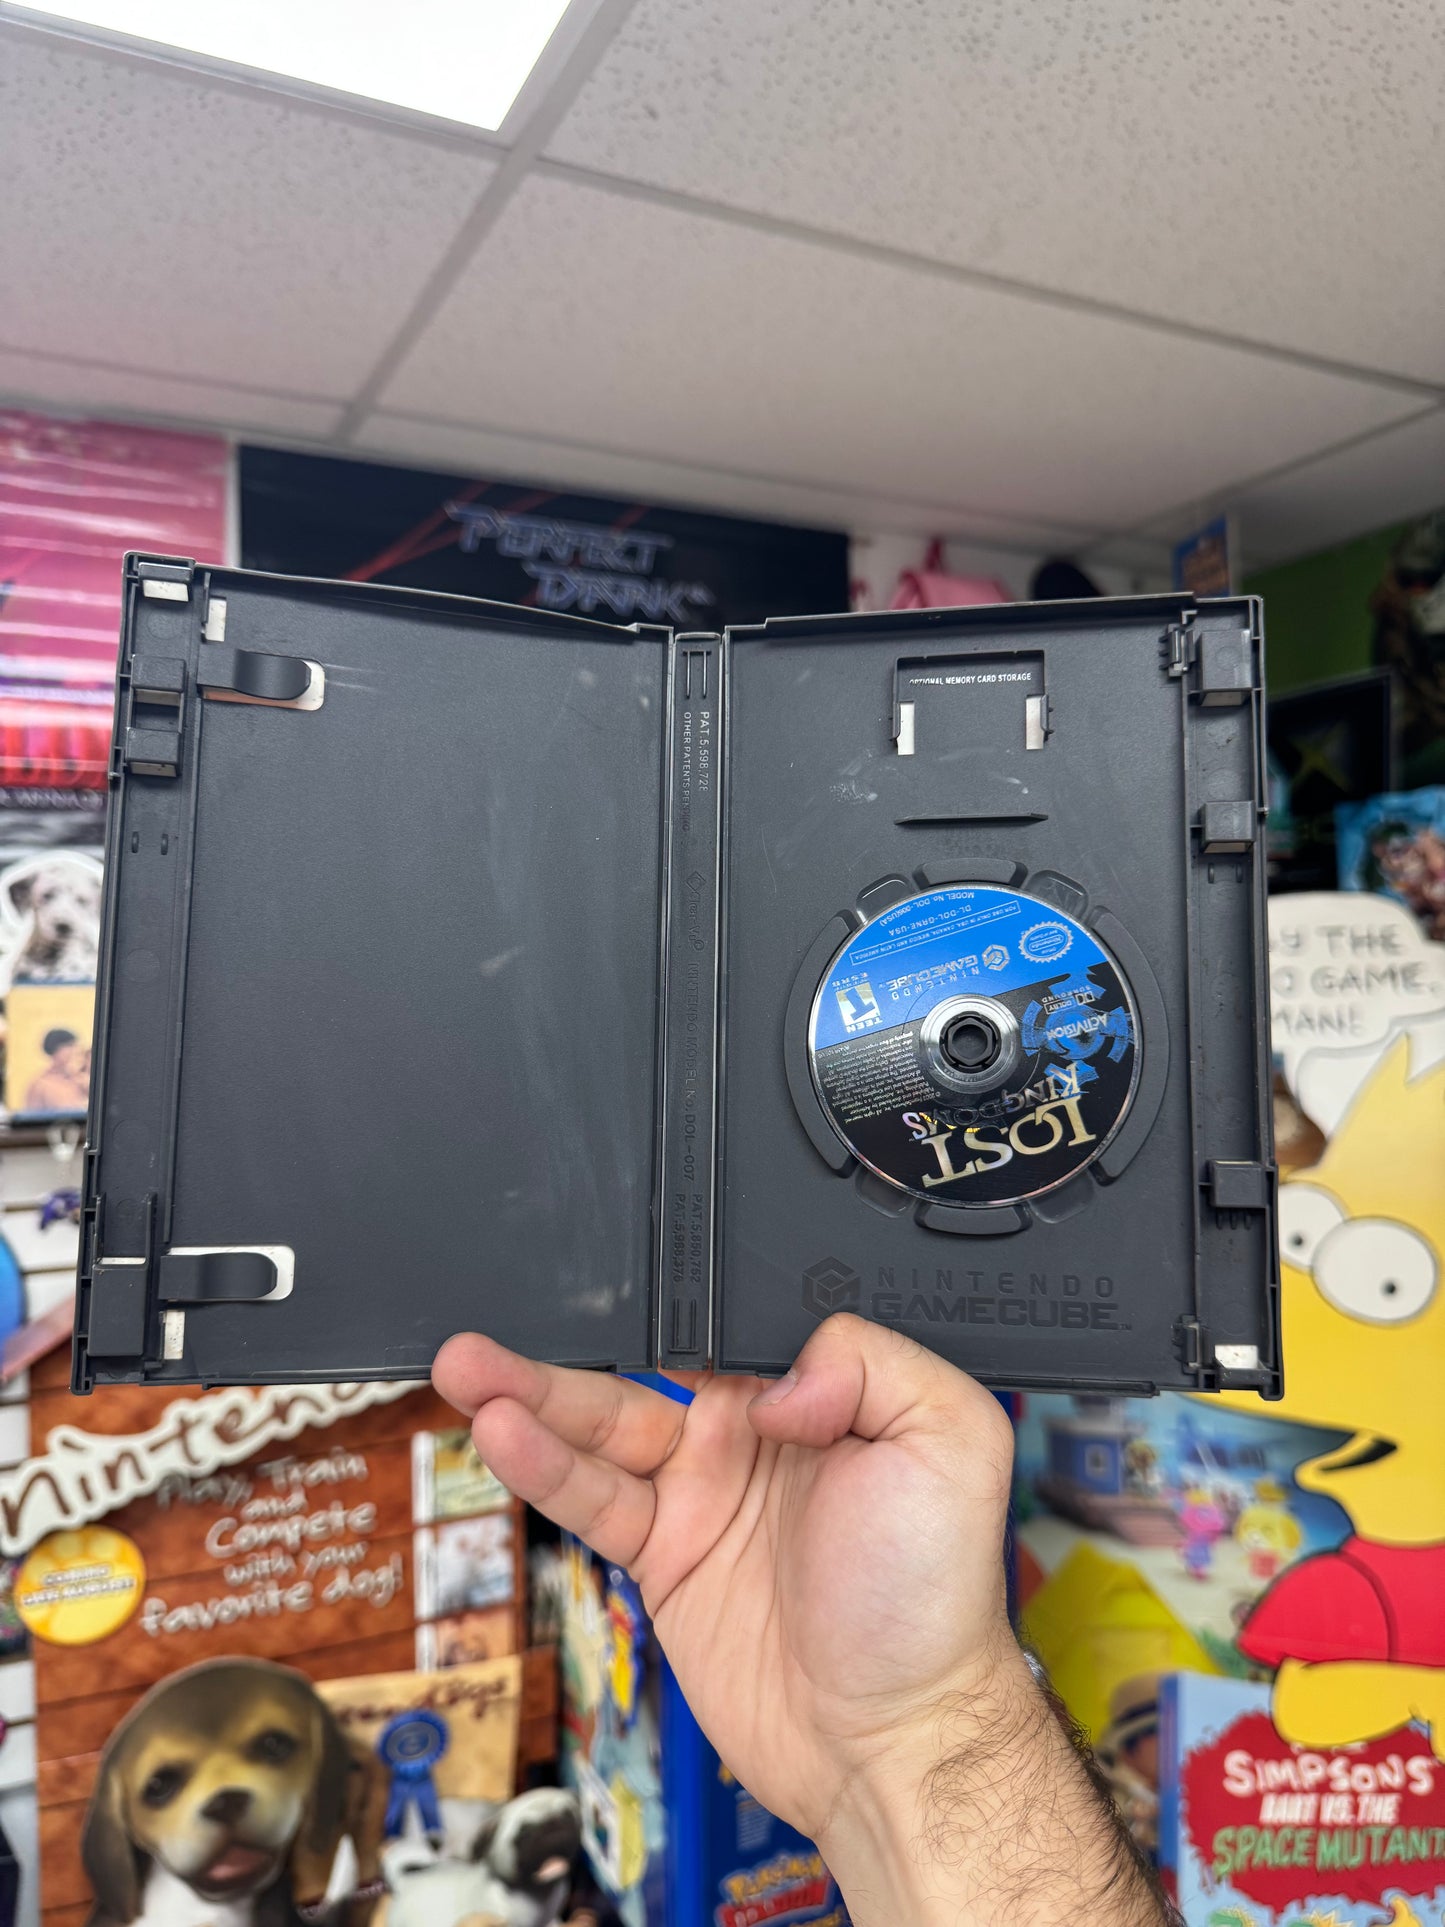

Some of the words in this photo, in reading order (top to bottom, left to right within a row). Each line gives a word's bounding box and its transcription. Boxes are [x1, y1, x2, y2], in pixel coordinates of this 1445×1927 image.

[444, 502, 676, 575] PERFECT
[945, 676, 974, 684] MEMORY
[977, 675, 996, 683] CARD
[998, 672, 1030, 681] STORAGE
[682, 711, 691, 743] OTHER
[681, 745, 690, 787] PATENTS
[945, 891, 973, 899] MODEL
[886, 955, 978, 991] GAMECUBE
[891, 965, 981, 1002] NINTENDO
[1048, 1000, 1072, 1011] DOLBY
[846, 1016, 883, 1034] TEEN
[1045, 1013, 1106, 1039] ACTIVISION
[920, 1095, 1096, 1188] LOST
[878, 1266, 1113, 1298] NINTENDO
[256, 1447, 369, 1490] Train
[240, 1490, 307, 1521] and
[204, 1501, 378, 1558] Compete
[223, 1548, 296, 1586] with
[302, 1541, 370, 1577] your
[141, 1580, 314, 1637] favorite
[321, 1552, 403, 1608] dog!
[1223, 1750, 1434, 1797] SIMPSONS
[1358, 1792, 1402, 1824] THE
[1212, 1827, 1315, 1876] SPACE
